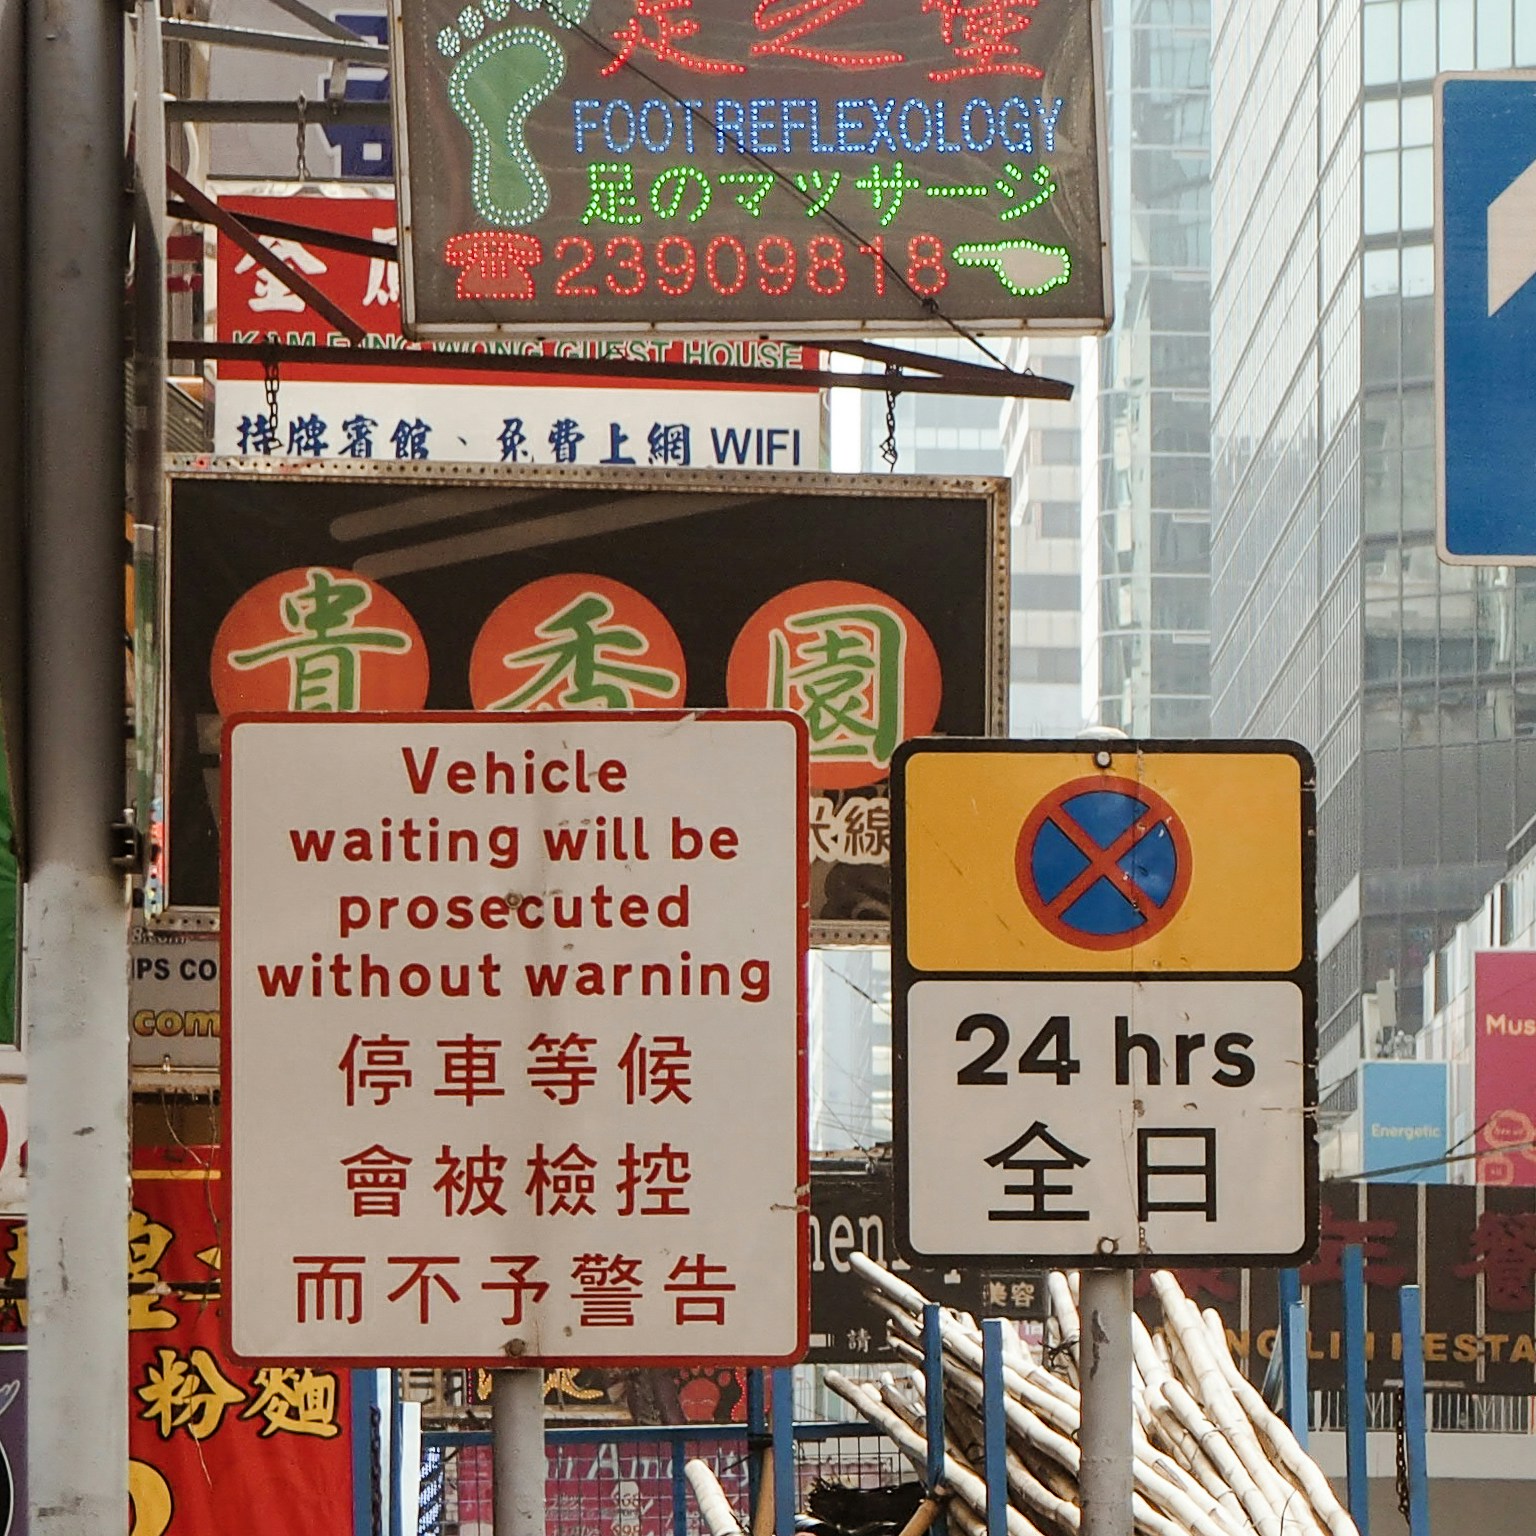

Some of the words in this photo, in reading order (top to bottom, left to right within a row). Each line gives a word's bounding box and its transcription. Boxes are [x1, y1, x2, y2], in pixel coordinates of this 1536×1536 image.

[573, 98, 704, 154] FOOT
[716, 96, 1065, 154] REFLEXOLOGY
[580, 161, 1058, 226] 足のマッサージ
[553, 234, 949, 297] 23909818
[327, 332, 412, 351] FNG
[684, 341, 804, 371] HOUSE
[711, 426, 801, 466] WIFI
[402, 746, 628, 795] Vehicle
[290, 817, 519, 869] waiting
[545, 819, 649, 861] will
[671, 818, 739, 861] be
[340, 885, 690, 938] prosecuted
[258, 953, 501, 998] without
[527, 951, 770, 1004] warning
[338, 1033, 692, 1107] 停車等候
[955, 1013, 1081, 1086] 24
[1115, 1015, 1256, 1087] hrs
[1371, 1124, 1441, 1141] Energetic
[340, 1142, 691, 1217] 會被檢控
[983, 1120, 1217, 1223] 全日
[293, 1254, 736, 1327] 而不予警告
